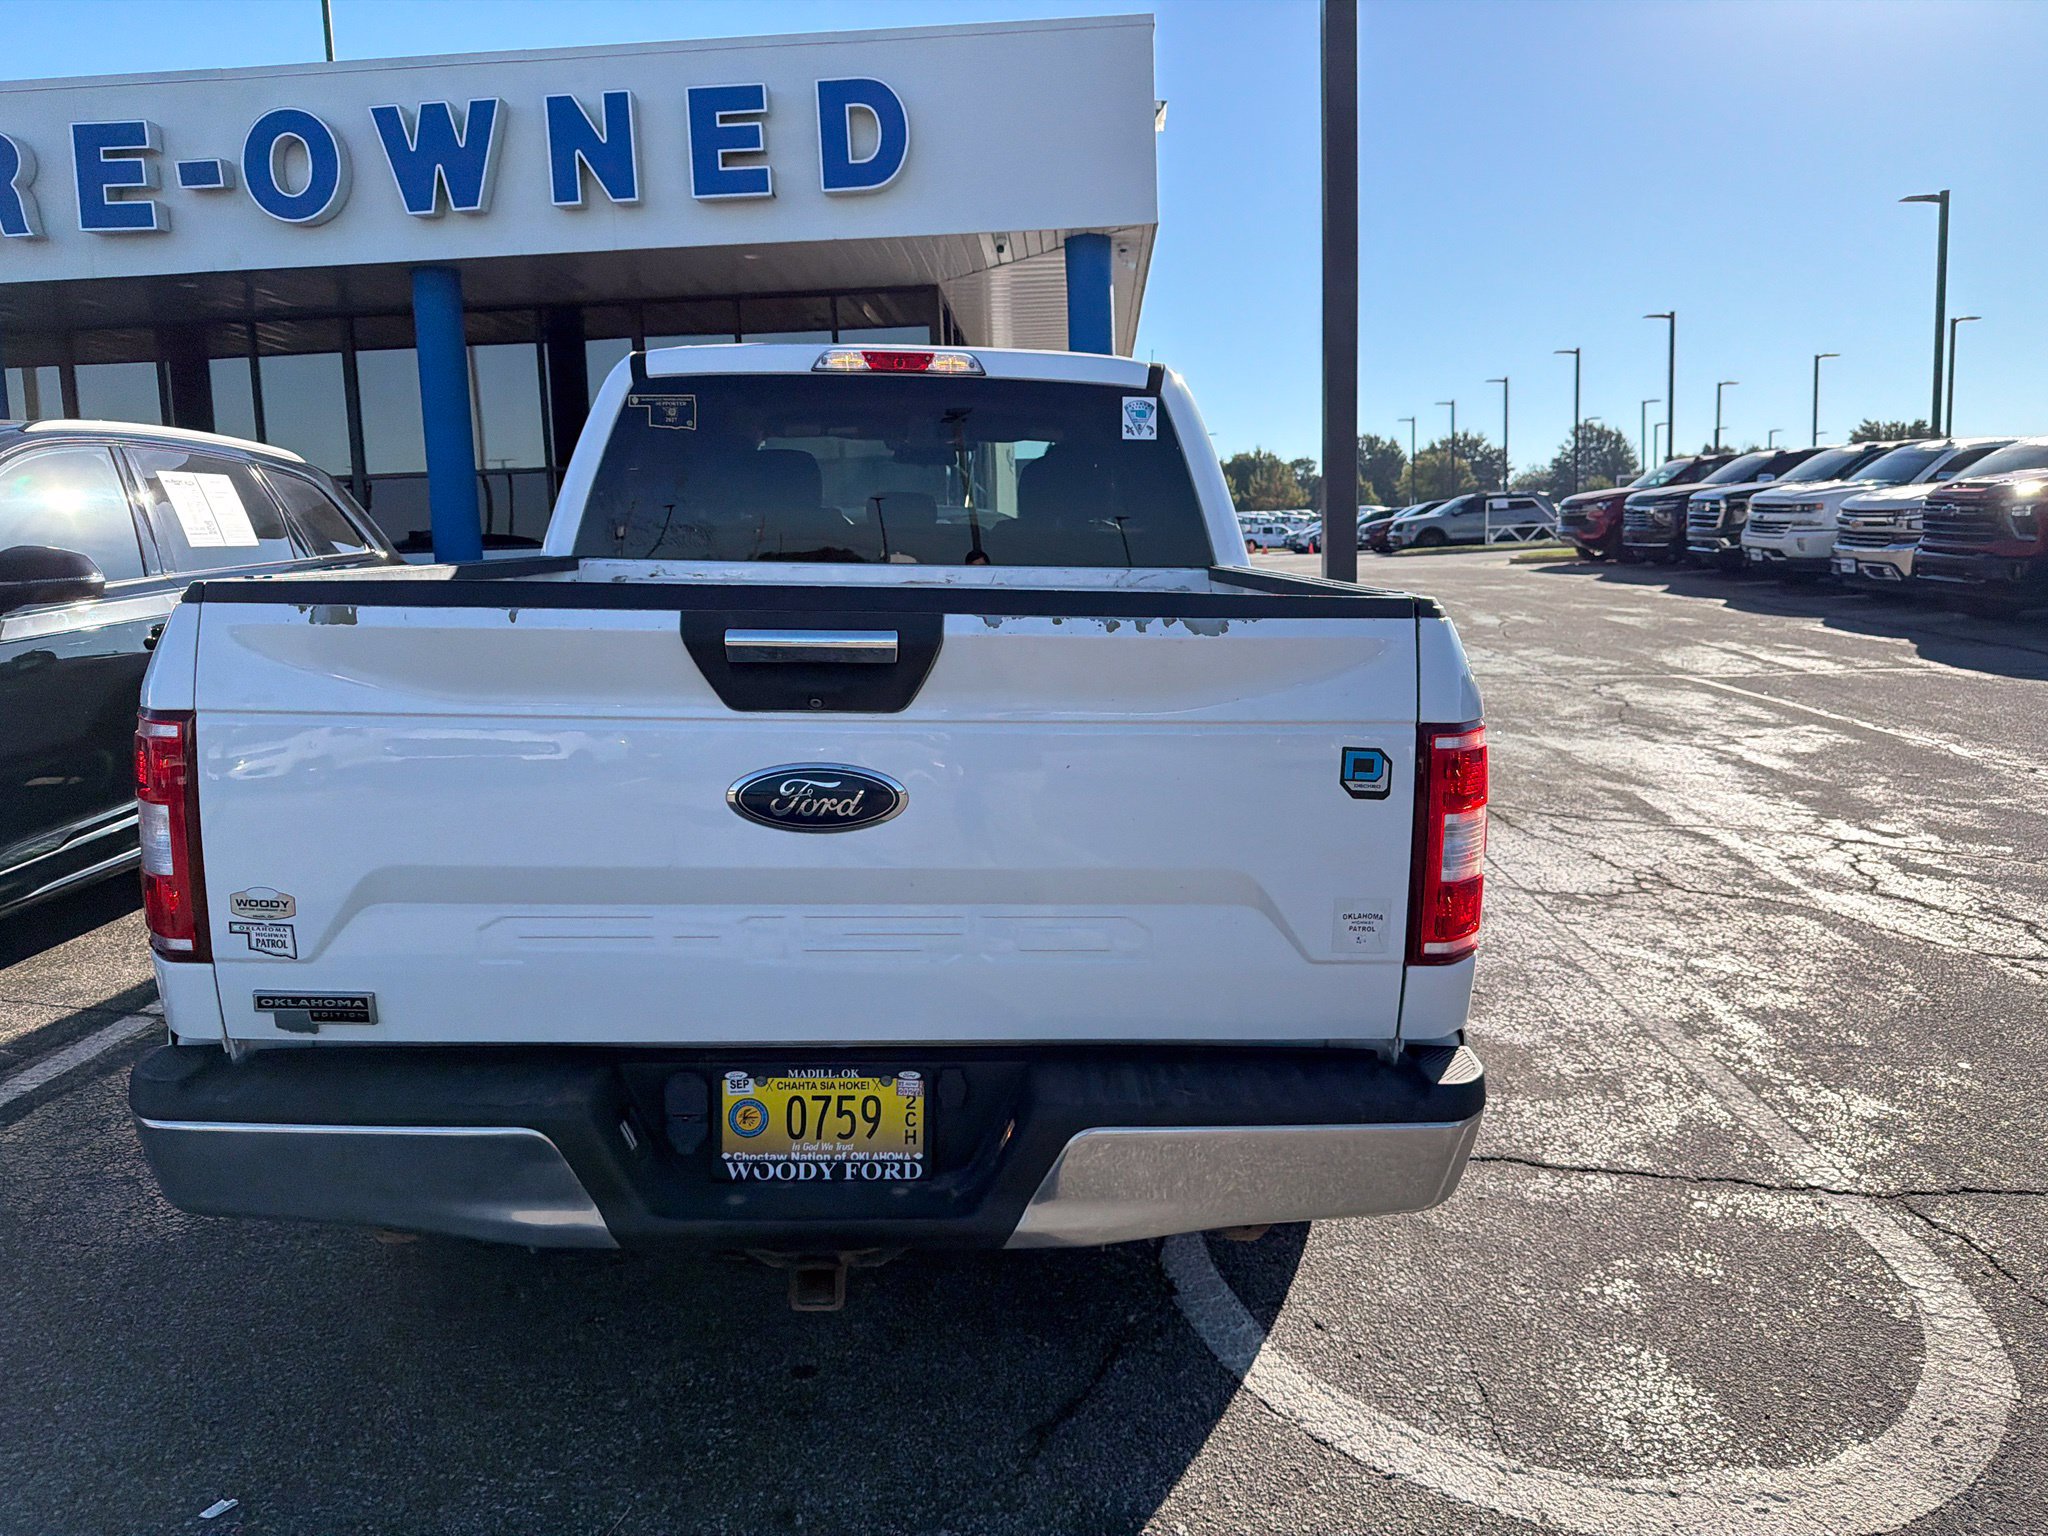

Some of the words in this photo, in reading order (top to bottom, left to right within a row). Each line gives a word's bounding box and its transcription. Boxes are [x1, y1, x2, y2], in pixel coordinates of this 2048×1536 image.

[769, 778, 865, 817] Ford
[235, 898, 290, 909] WOODY
[1342, 912, 1384, 921] OKLAHOMA
[238, 925, 288, 933] OKLAHOMA
[255, 938, 289, 949] PATROL
[260, 998, 365, 1008] OKLAHOMA
[841, 1069, 860, 1078] OK
[729, 1079, 750, 1090] SEP
[776, 1081, 818, 1091] CHAHTA
[819, 1081, 836, 1090] SIA
[838, 1081, 870, 1090] HOKE!
[786, 1095, 882, 1140] 0759
[791, 1142, 801, 1150] In
[802, 1142, 820, 1151] God
[821, 1142, 834, 1150] We
[834, 1142, 854, 1151] Trust
[733, 1152, 788, 1160] Choctaw
[790, 1152, 832, 1160] Nation
[834, 1152, 847, 1160] of
[850, 1152, 911, 1160] OKLAHOMA
[725, 1161, 837, 1181] WOODY
[843, 1161, 923, 1181] FORD
